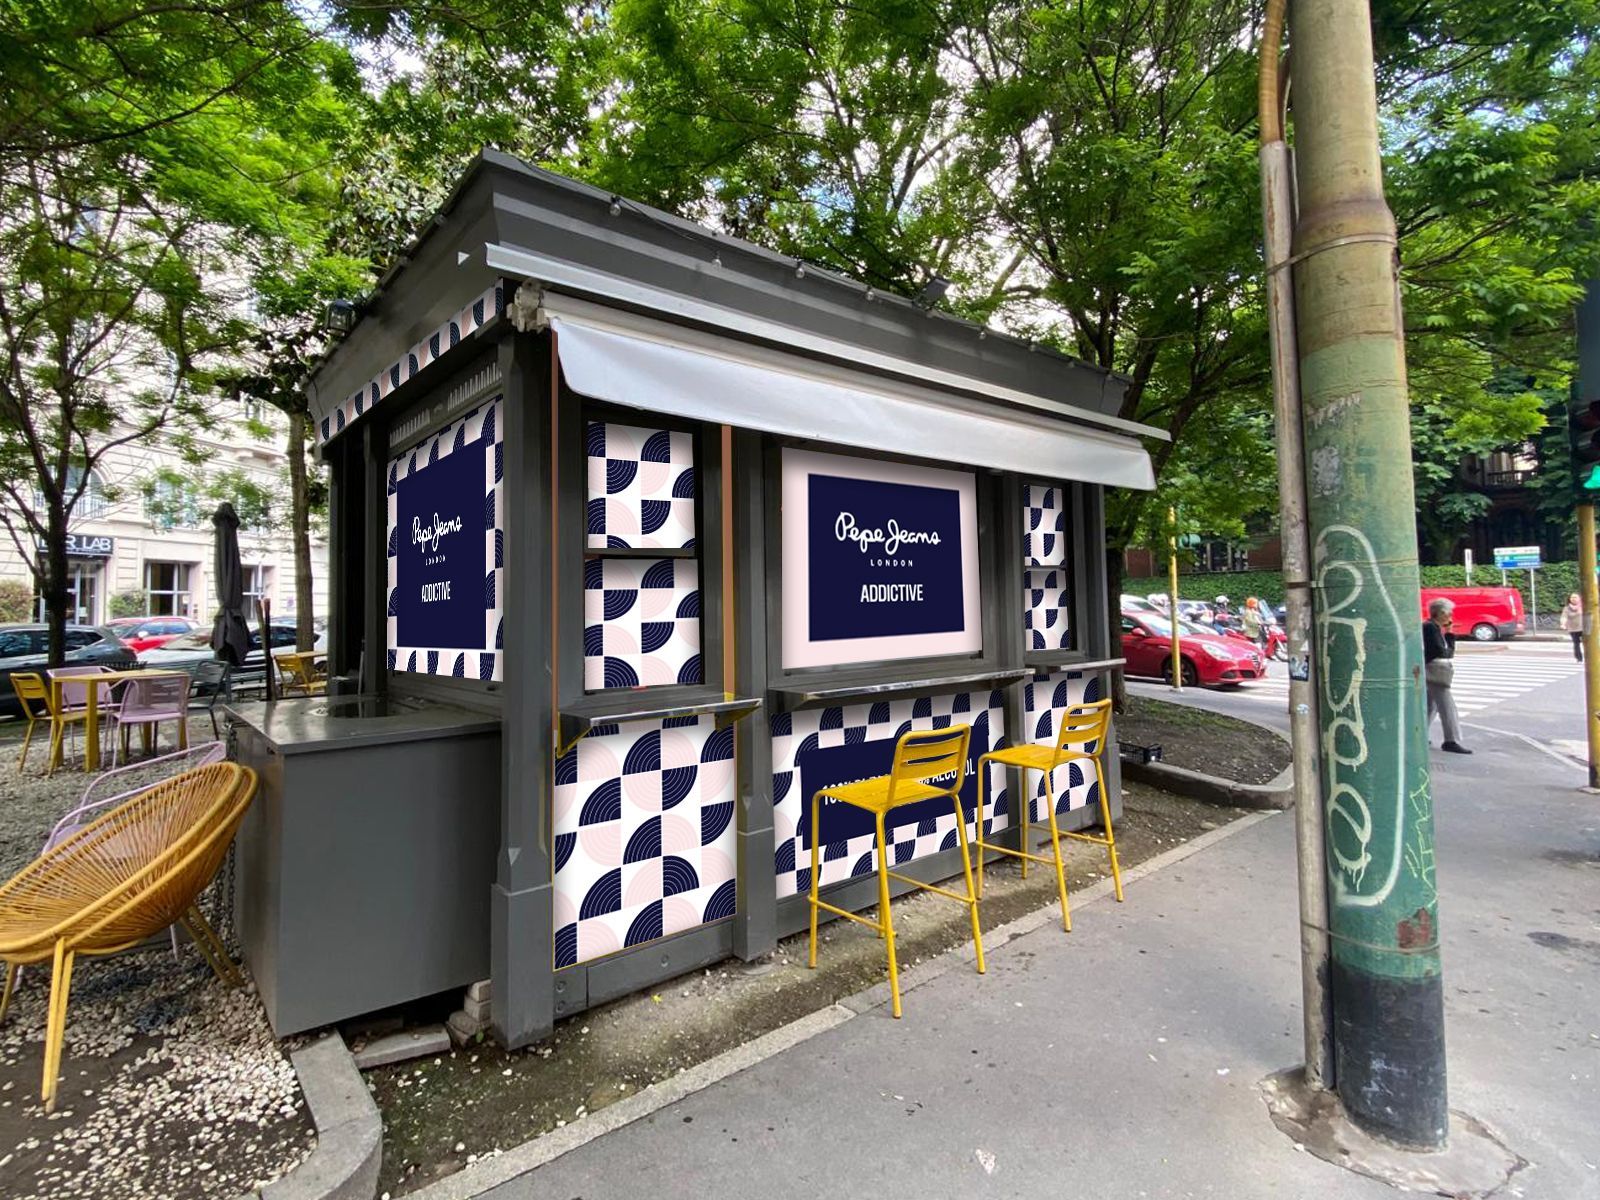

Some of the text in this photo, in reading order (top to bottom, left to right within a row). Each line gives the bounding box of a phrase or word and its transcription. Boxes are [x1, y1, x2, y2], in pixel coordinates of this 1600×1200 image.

[412, 512, 462, 553] Pepe Jeans
[835, 512, 941, 555] Pepe Jeans
[82, 536, 111, 551] LAB
[870, 559, 913, 567] LONDON
[421, 580, 451, 603] ADDICTIVE
[860, 584, 924, 603] ADDICTIVE
